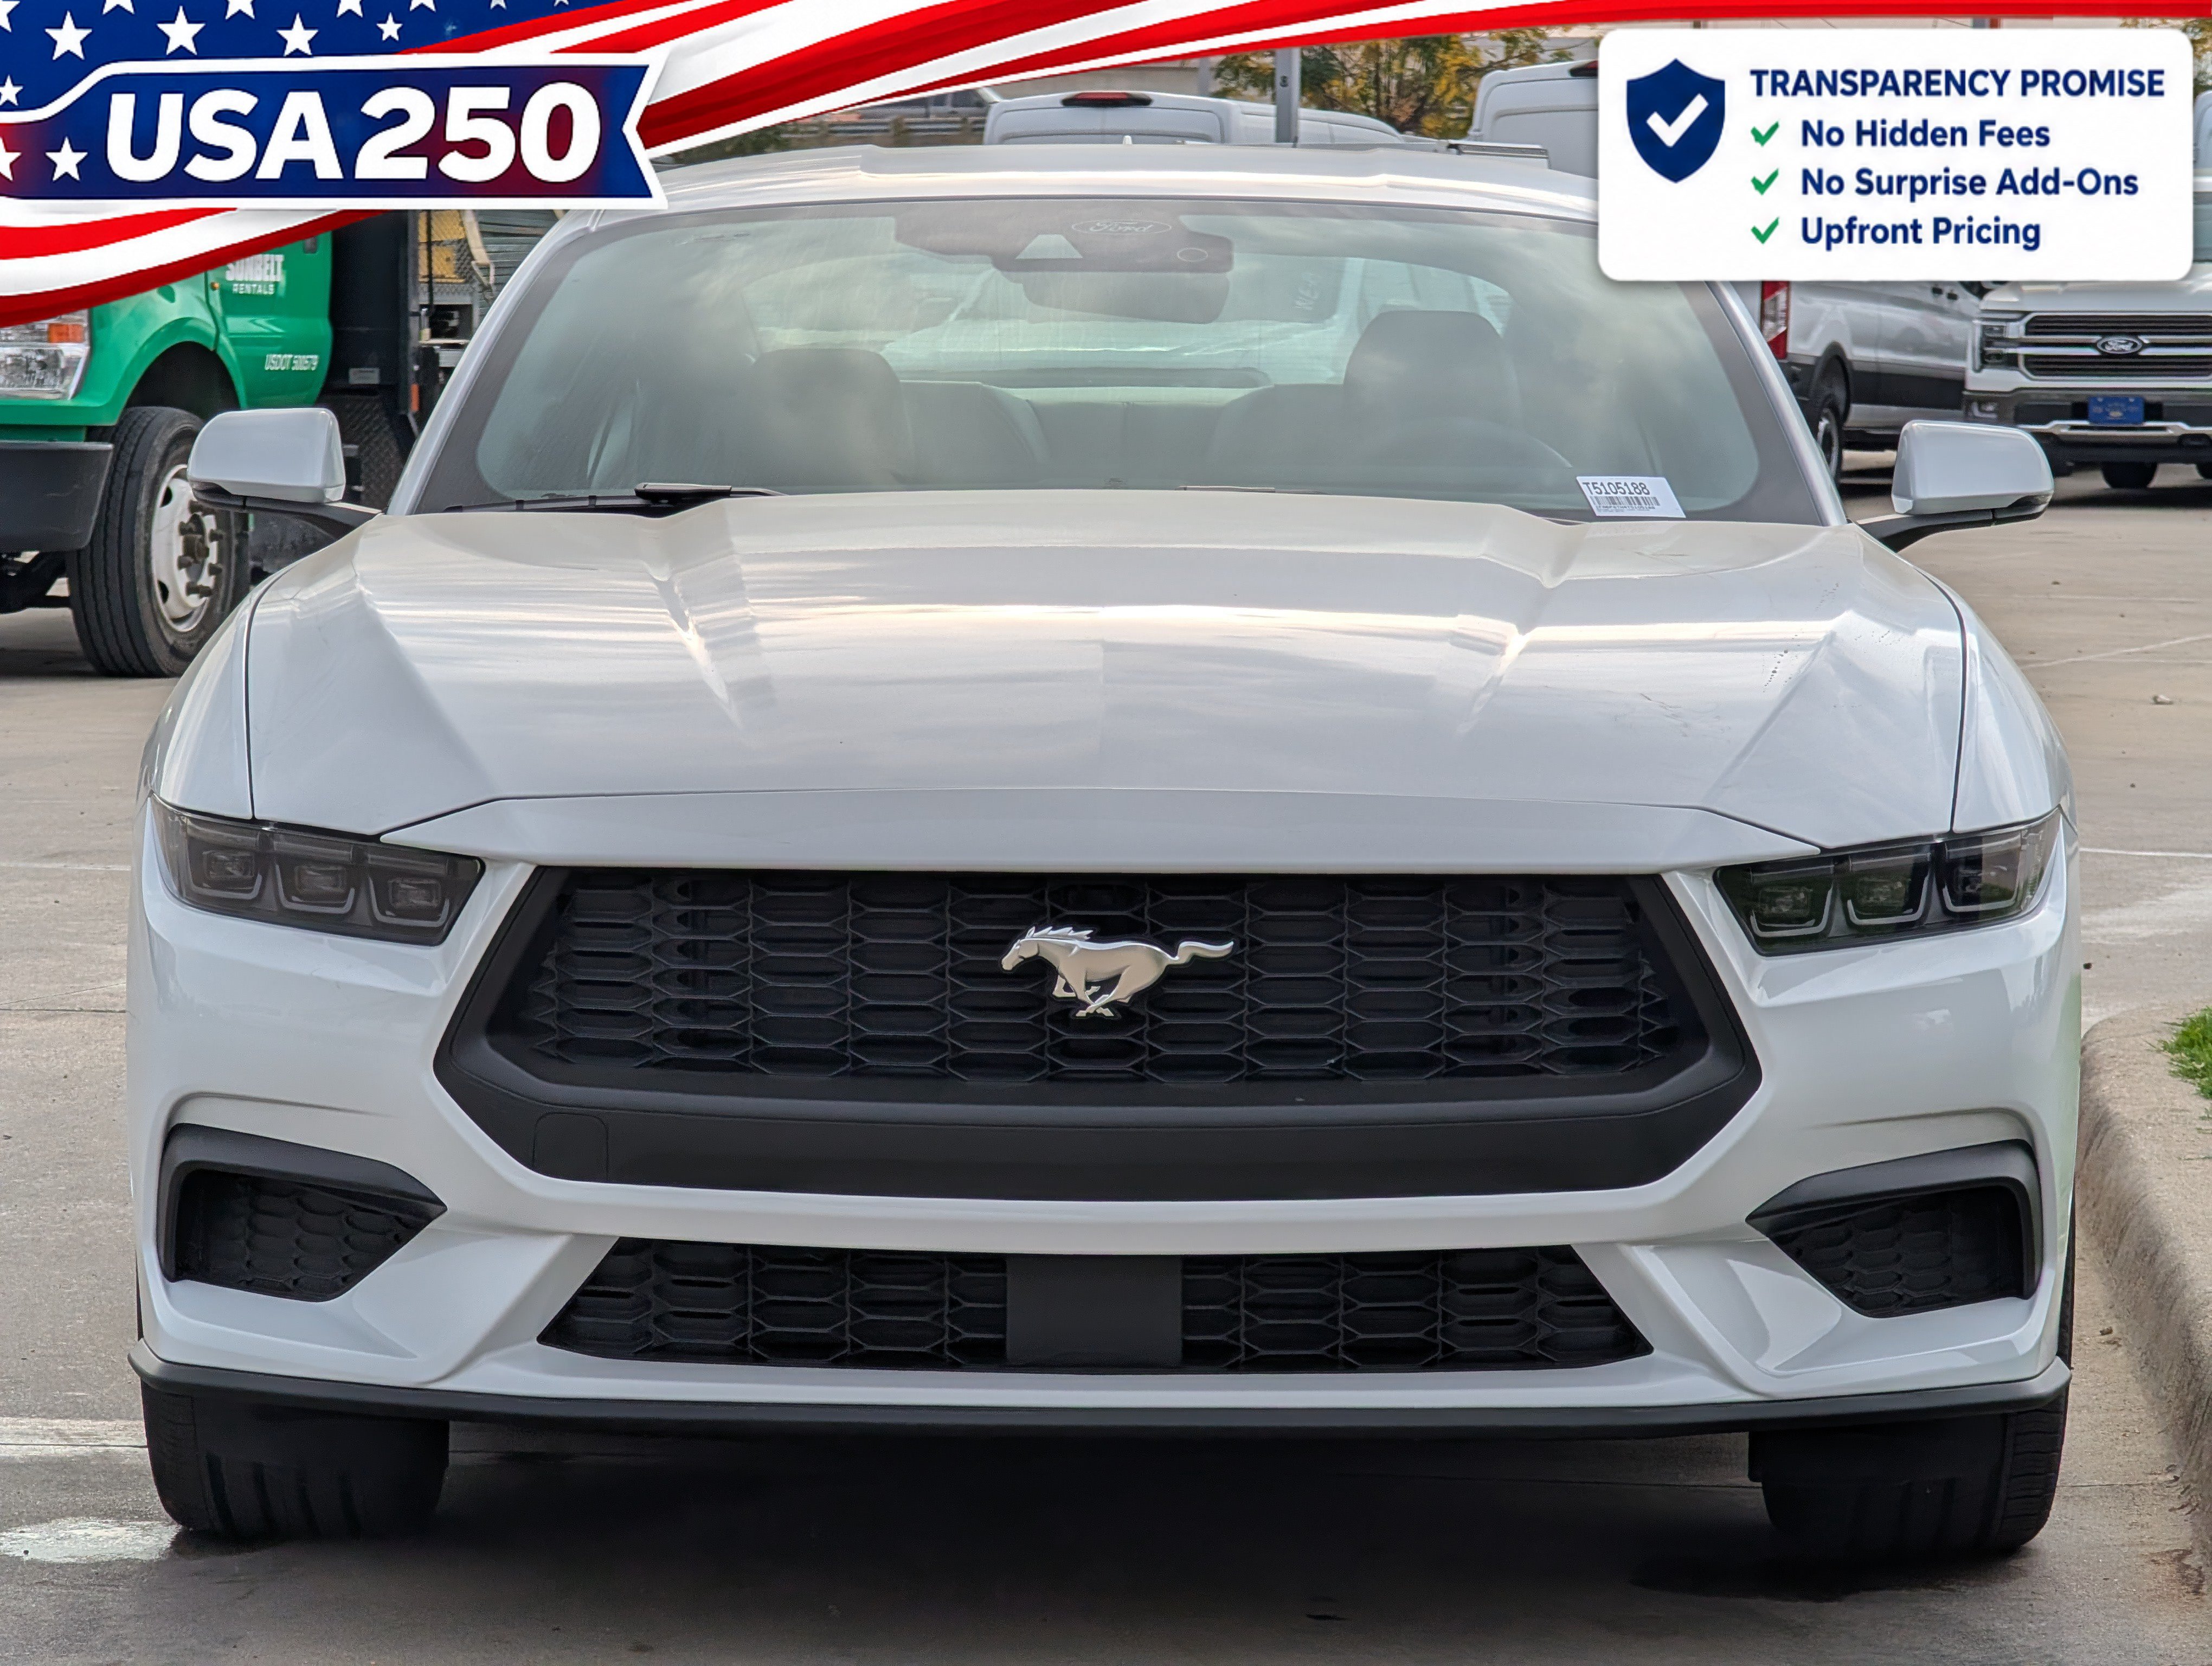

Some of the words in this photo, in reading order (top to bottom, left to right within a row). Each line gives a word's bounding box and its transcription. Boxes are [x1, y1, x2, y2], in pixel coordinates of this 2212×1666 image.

[1089, 220, 1154, 233] Ford
[233, 284, 274, 294] RENTALS
[1582, 482, 1650, 495] T5105188
